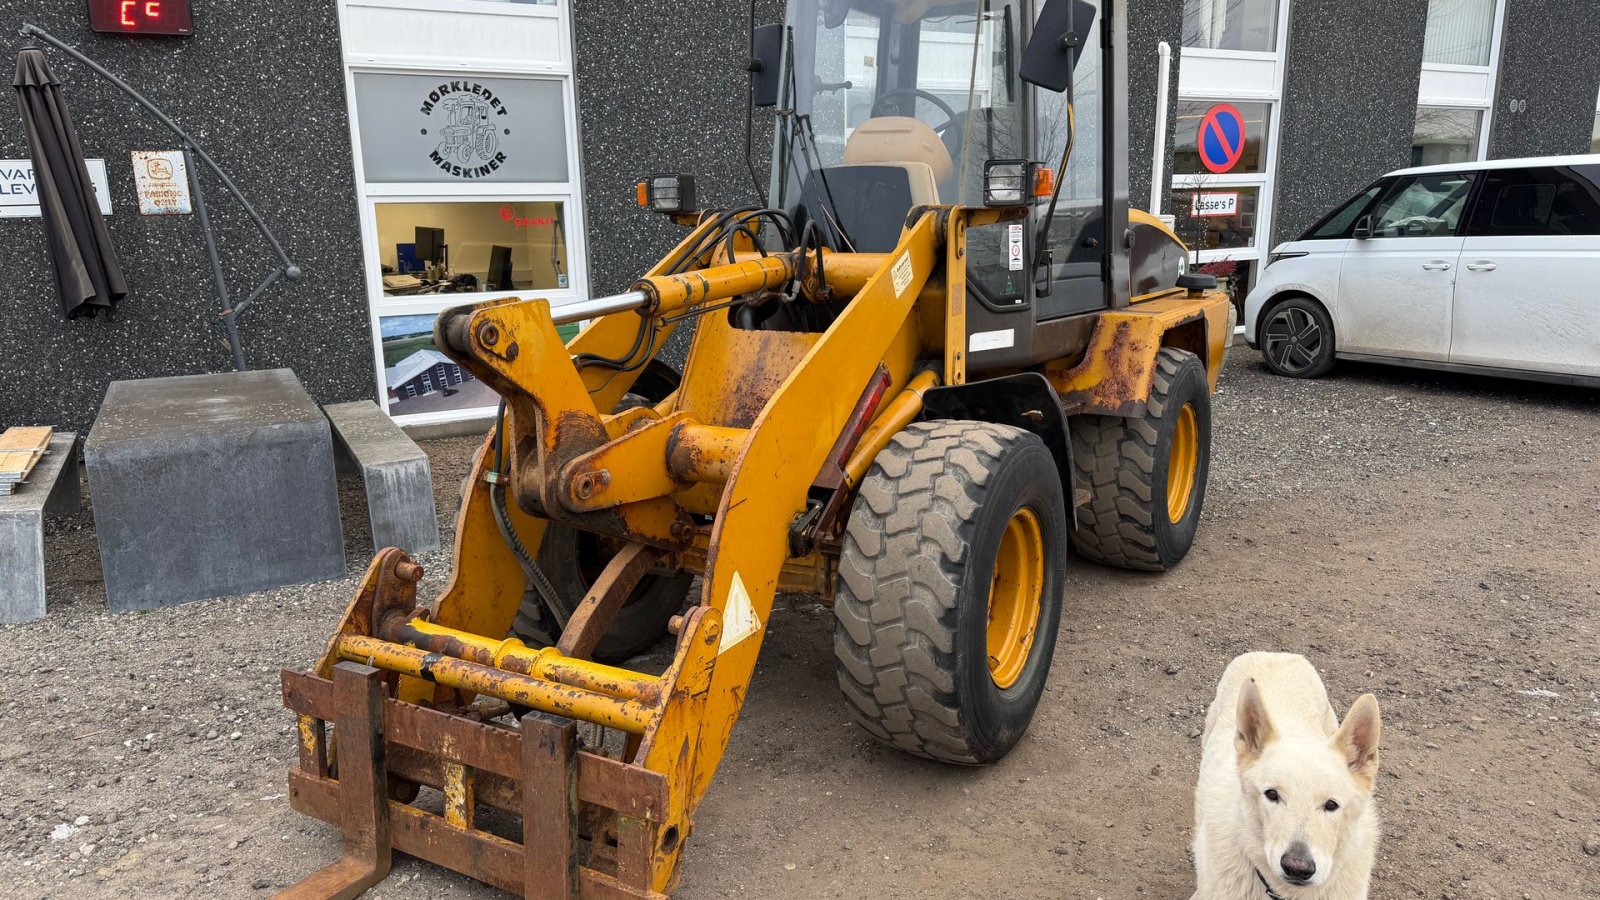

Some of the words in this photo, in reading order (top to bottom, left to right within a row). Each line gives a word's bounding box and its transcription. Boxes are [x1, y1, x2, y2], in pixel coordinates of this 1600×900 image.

[420, 80, 508, 116] MØRKLEDET
[429, 149, 507, 179] MASKINER
[1228, 198, 1235, 209] P
